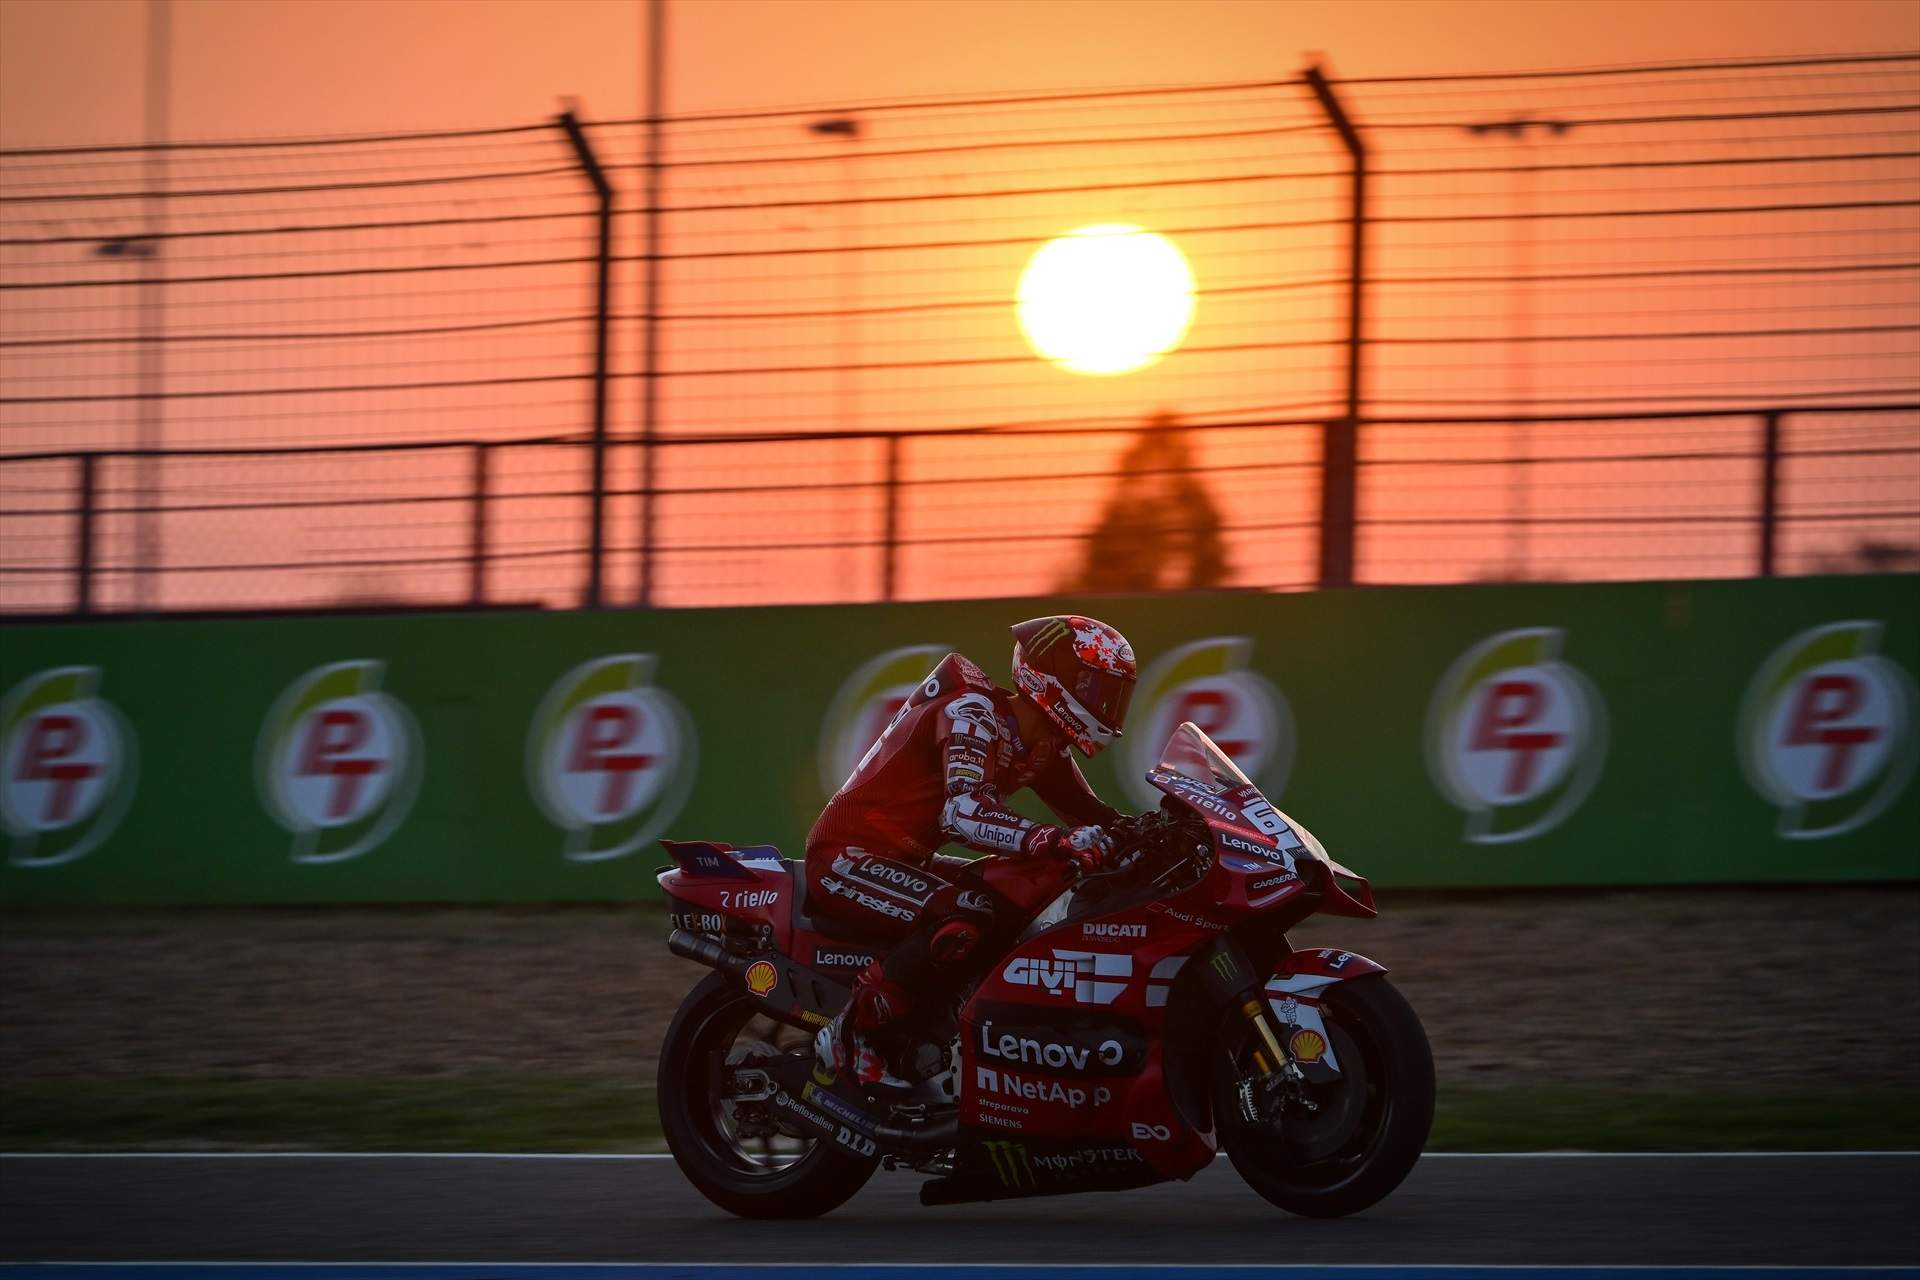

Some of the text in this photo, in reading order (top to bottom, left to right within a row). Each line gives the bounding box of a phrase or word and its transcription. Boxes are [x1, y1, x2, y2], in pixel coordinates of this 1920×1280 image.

[1054, 701, 1082, 731] Lenovo
[949, 751, 985, 767] aruba.it
[977, 807, 1018, 823] Lenovo
[1187, 794, 1237, 821] riello
[977, 823, 1017, 844] Unipol
[1221, 833, 1281, 861] Lenovo
[697, 857, 720, 868] TIM
[859, 858, 928, 893] Lenovo
[1253, 872, 1297, 889] CARRERA
[735, 890, 779, 909] riello
[820, 876, 915, 923] alpinestars
[1083, 923, 1148, 938] DUCATI
[1164, 907, 1230, 932] Audi Sport
[817, 950, 875, 967] Lenovo
[1003, 958, 1076, 995] GIVI
[982, 1020, 1123, 1071] Lenovo
[1003, 1074, 1112, 1109] NetApp
[823, 1099, 876, 1132] MICHELIN
[979, 1113, 1023, 1129] SIEMENS
